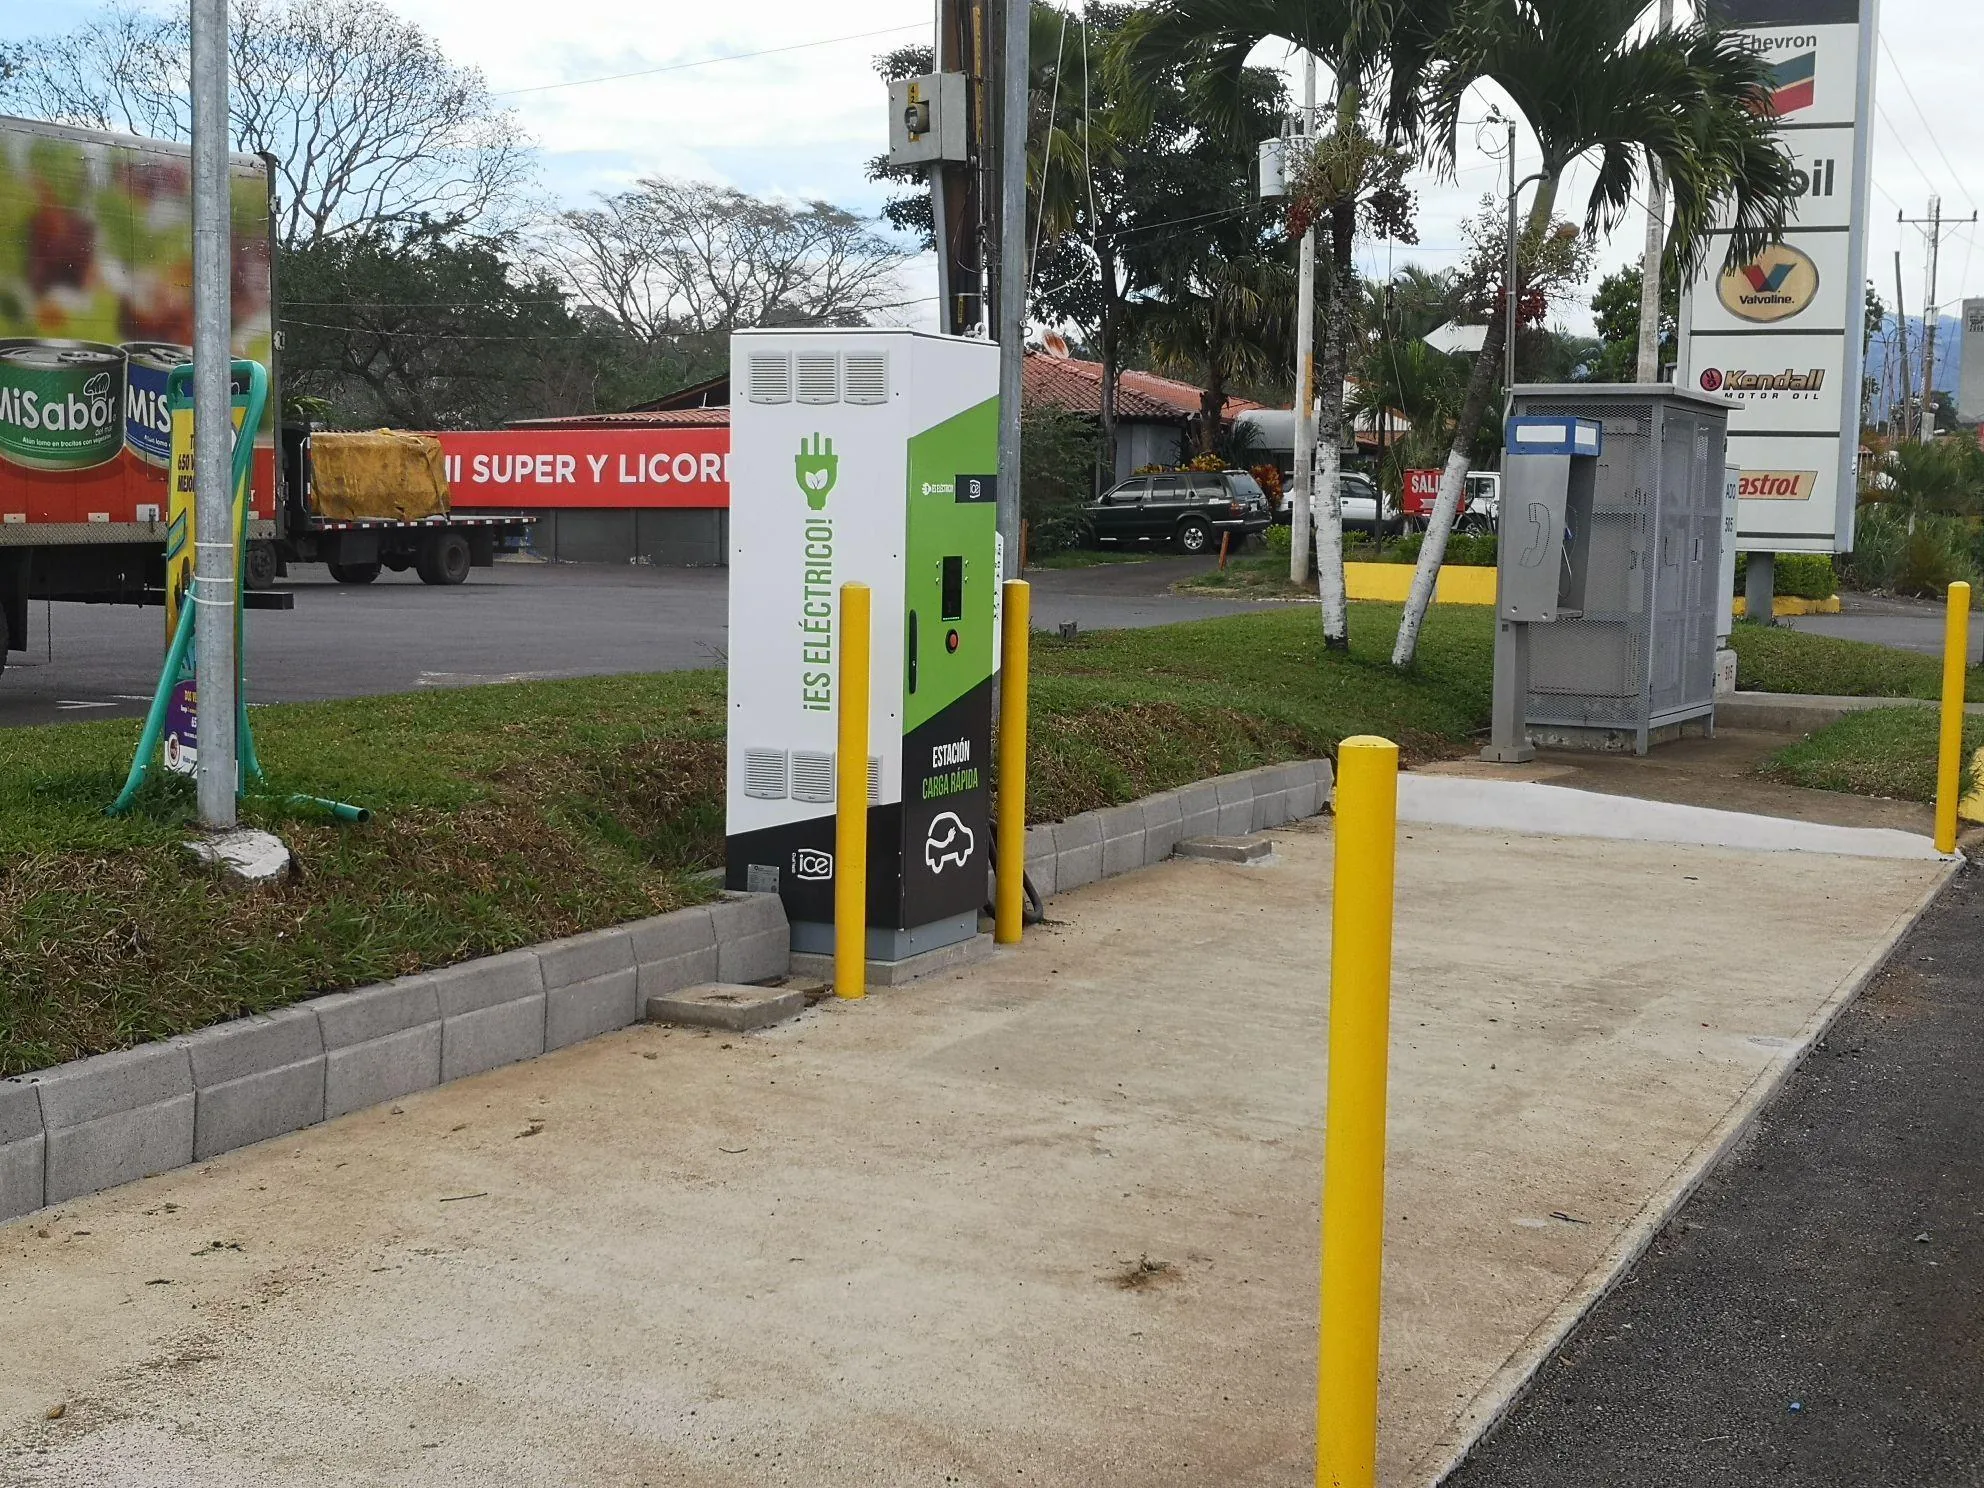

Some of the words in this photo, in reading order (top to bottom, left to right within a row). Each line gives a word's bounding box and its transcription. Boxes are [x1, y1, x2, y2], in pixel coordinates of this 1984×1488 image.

[1722, 369, 1826, 391] Kendall
[1724, 392, 1779, 400] MOTOR
[1792, 392, 1820, 400] OIL
[127, 384, 171, 433] MiS
[472, 454, 576, 483] SUPER
[587, 454, 608, 483] Y
[1411, 474, 1444, 494] SALI
[1738, 474, 1800, 495] astrol
[932, 736, 970, 768] ESTACIÓN
[922, 773, 949, 800] CARGA
[950, 766, 978, 793] RÁPIDA
[799, 853, 829, 874] ice
